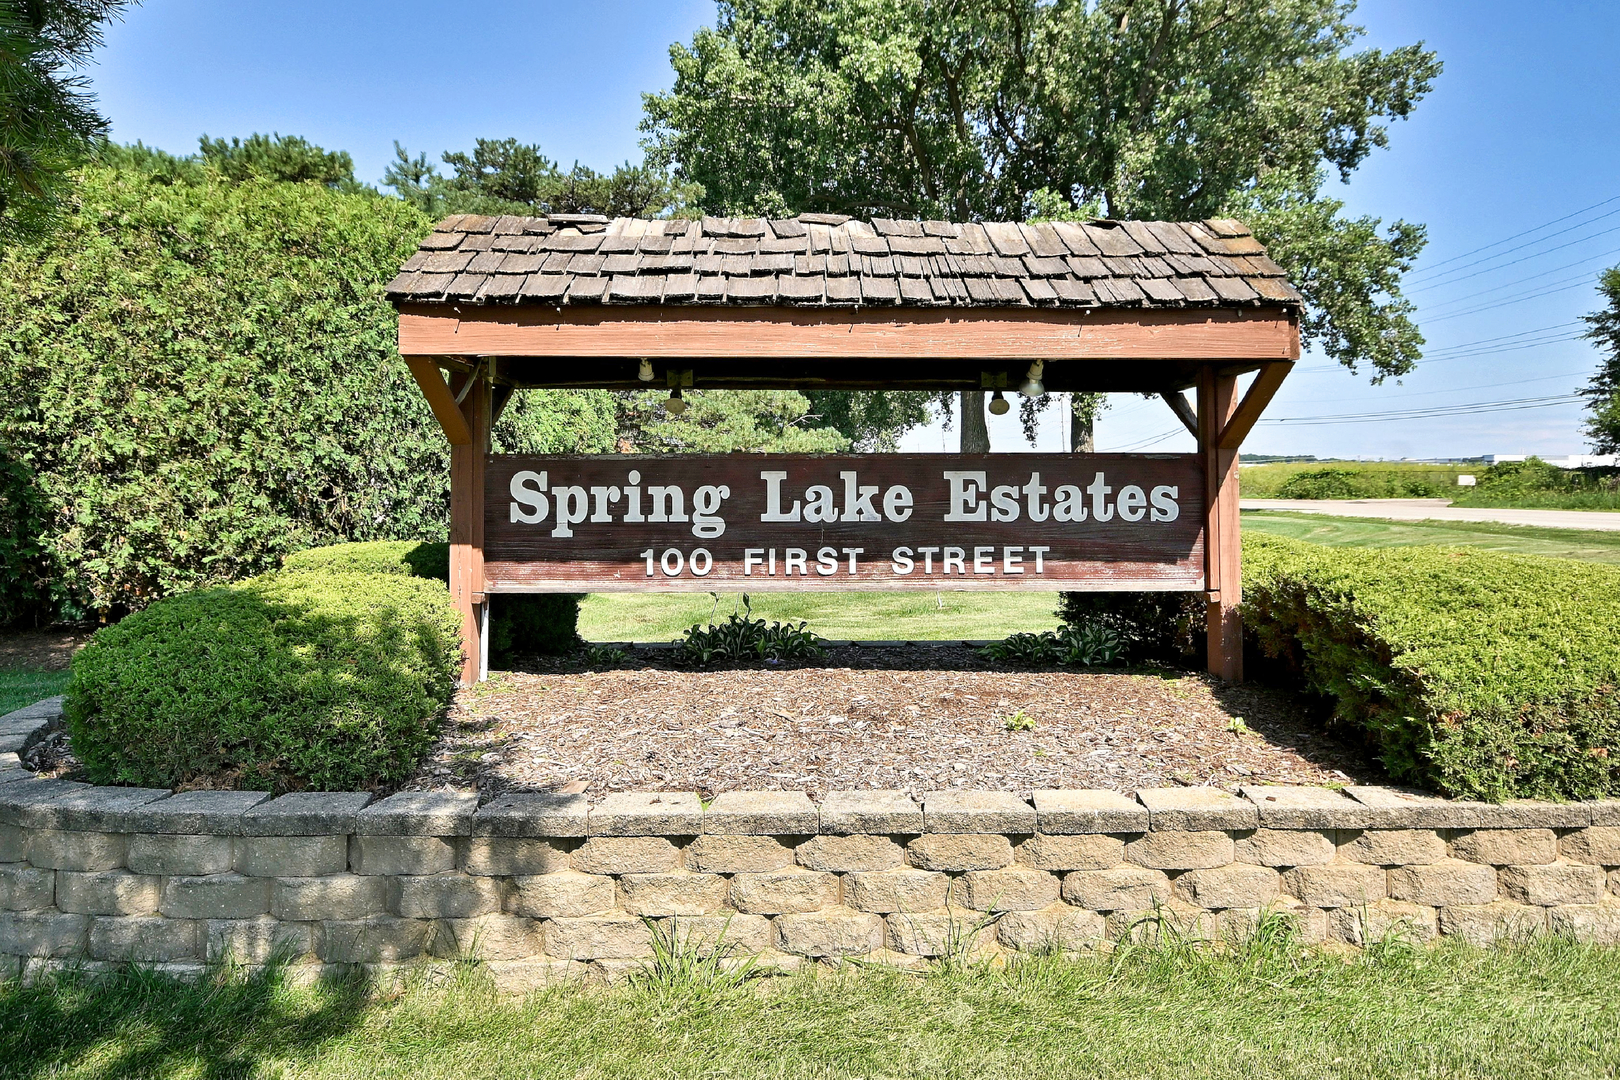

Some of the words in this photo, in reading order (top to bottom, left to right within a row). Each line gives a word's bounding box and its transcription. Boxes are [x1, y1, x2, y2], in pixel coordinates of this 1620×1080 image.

[509, 470, 731, 538] Spring
[760, 470, 914, 523] Lake
[943, 470, 1180, 523] Estates
[640, 547, 714, 577] 100
[744, 547, 865, 576] FIRST
[891, 546, 1050, 575] STREET
